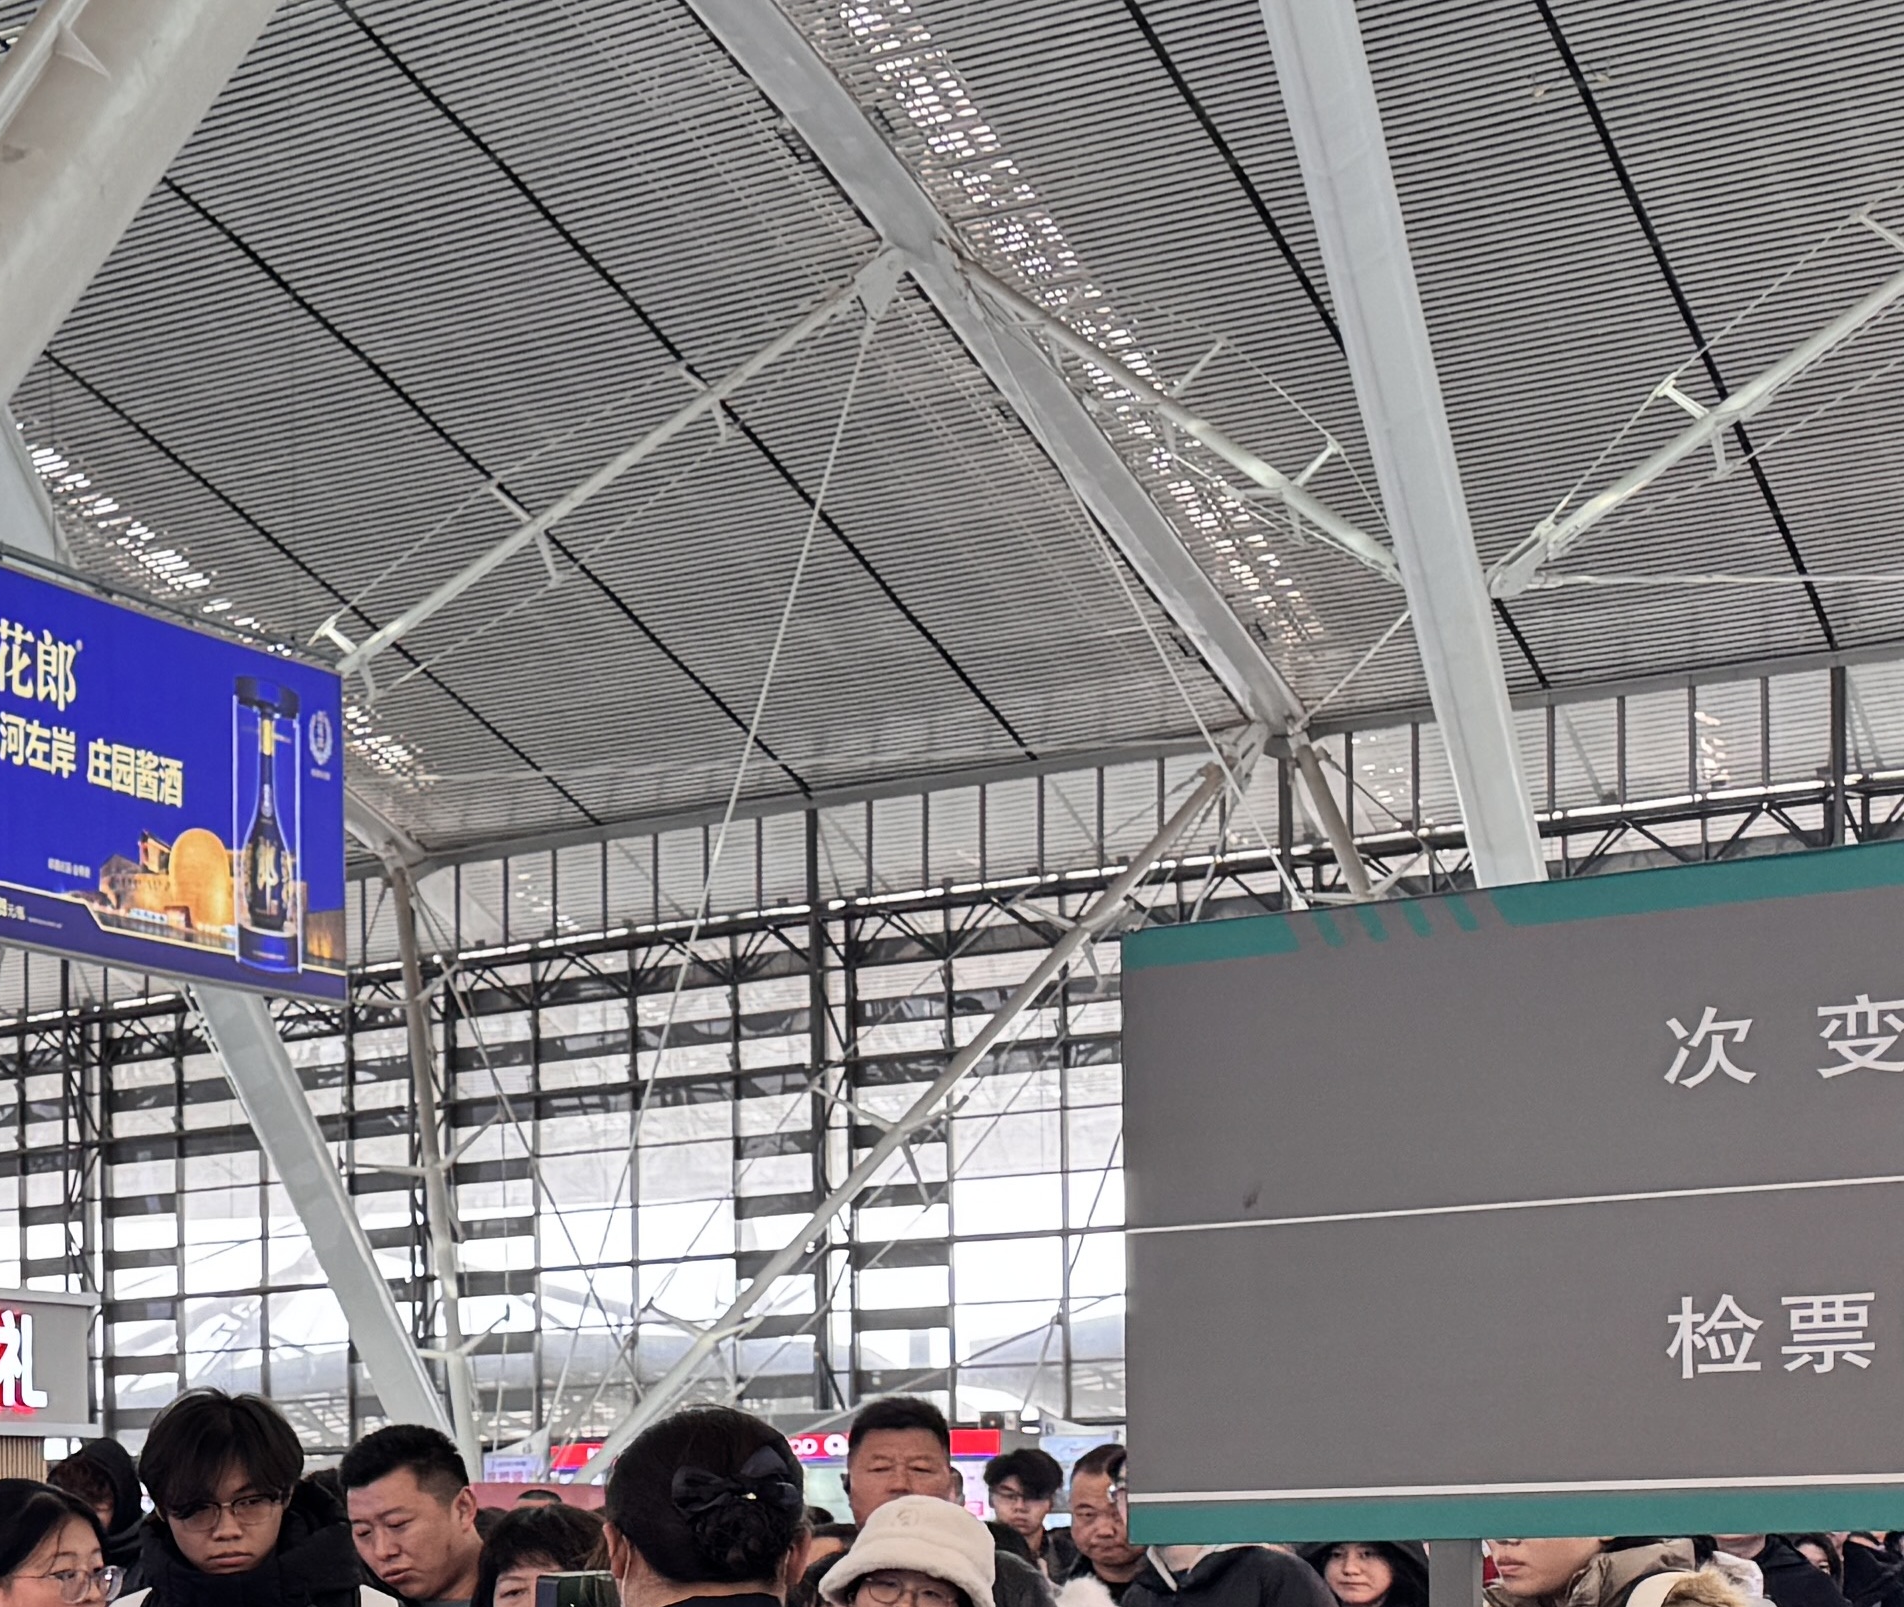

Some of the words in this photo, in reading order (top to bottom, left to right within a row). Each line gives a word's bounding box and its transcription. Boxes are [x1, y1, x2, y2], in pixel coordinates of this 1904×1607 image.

[87, 738, 183, 808] 庄园酱酒
[1666, 1292, 1876, 1379] 检票
